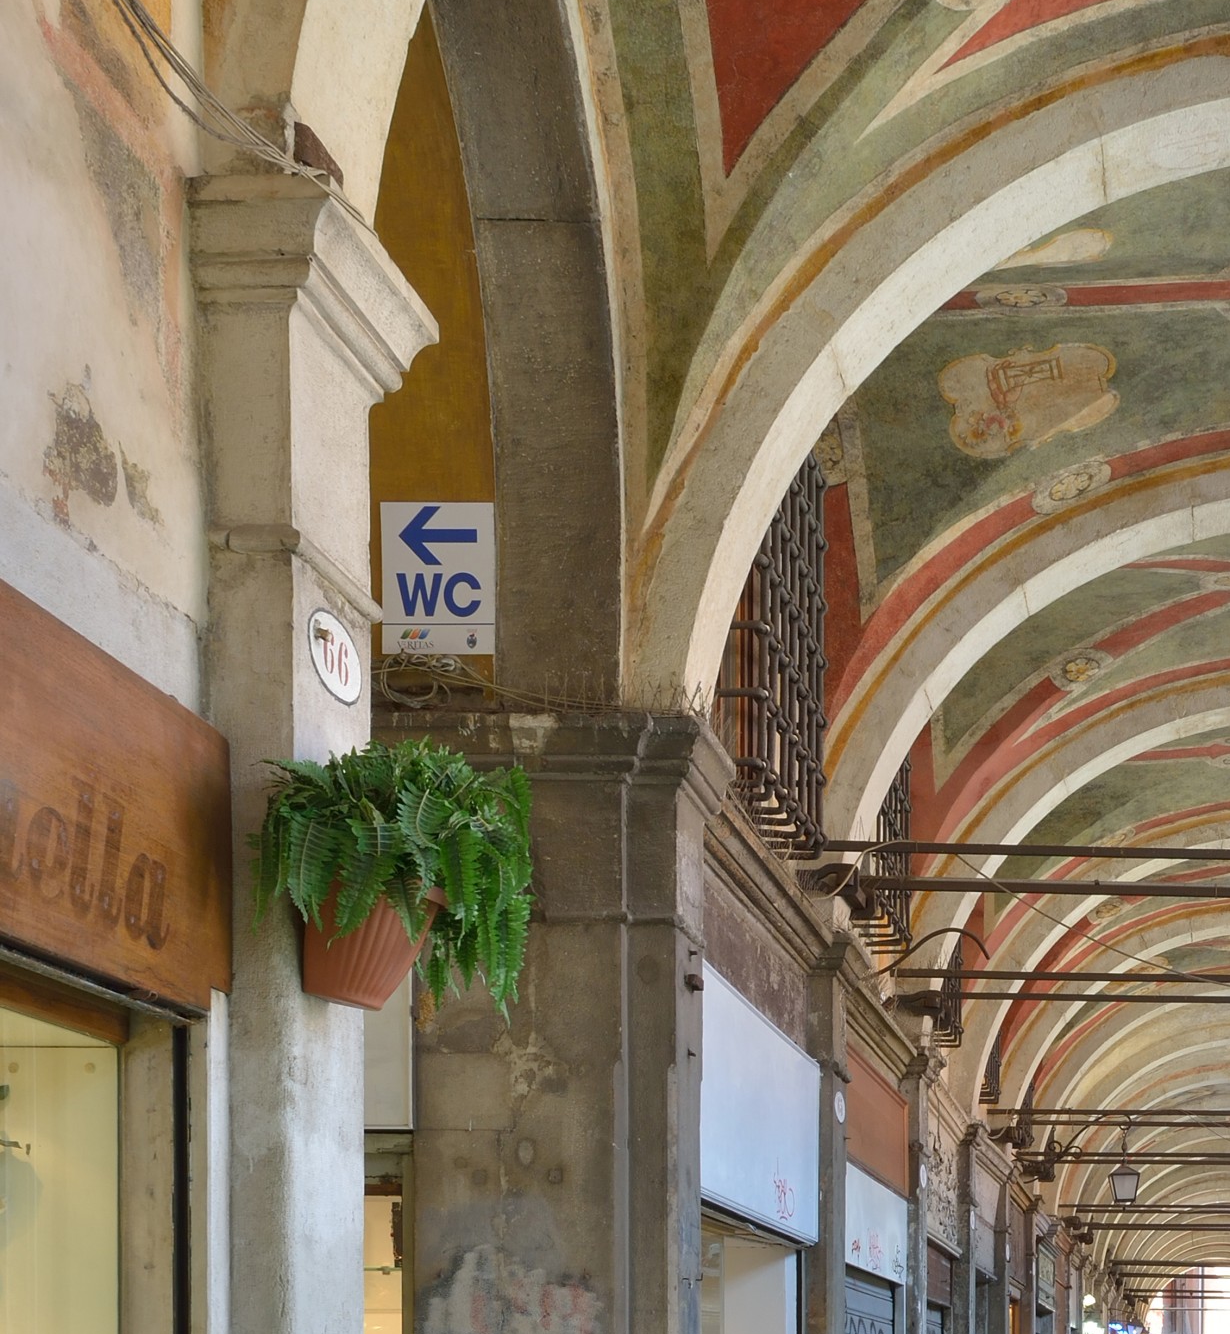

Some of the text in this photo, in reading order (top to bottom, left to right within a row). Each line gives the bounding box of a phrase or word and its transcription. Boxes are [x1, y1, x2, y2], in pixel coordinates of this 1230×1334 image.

[396, 572, 481, 617] WC
[323, 630, 348, 686] 66
[397, 640, 434, 651] VERITAS
